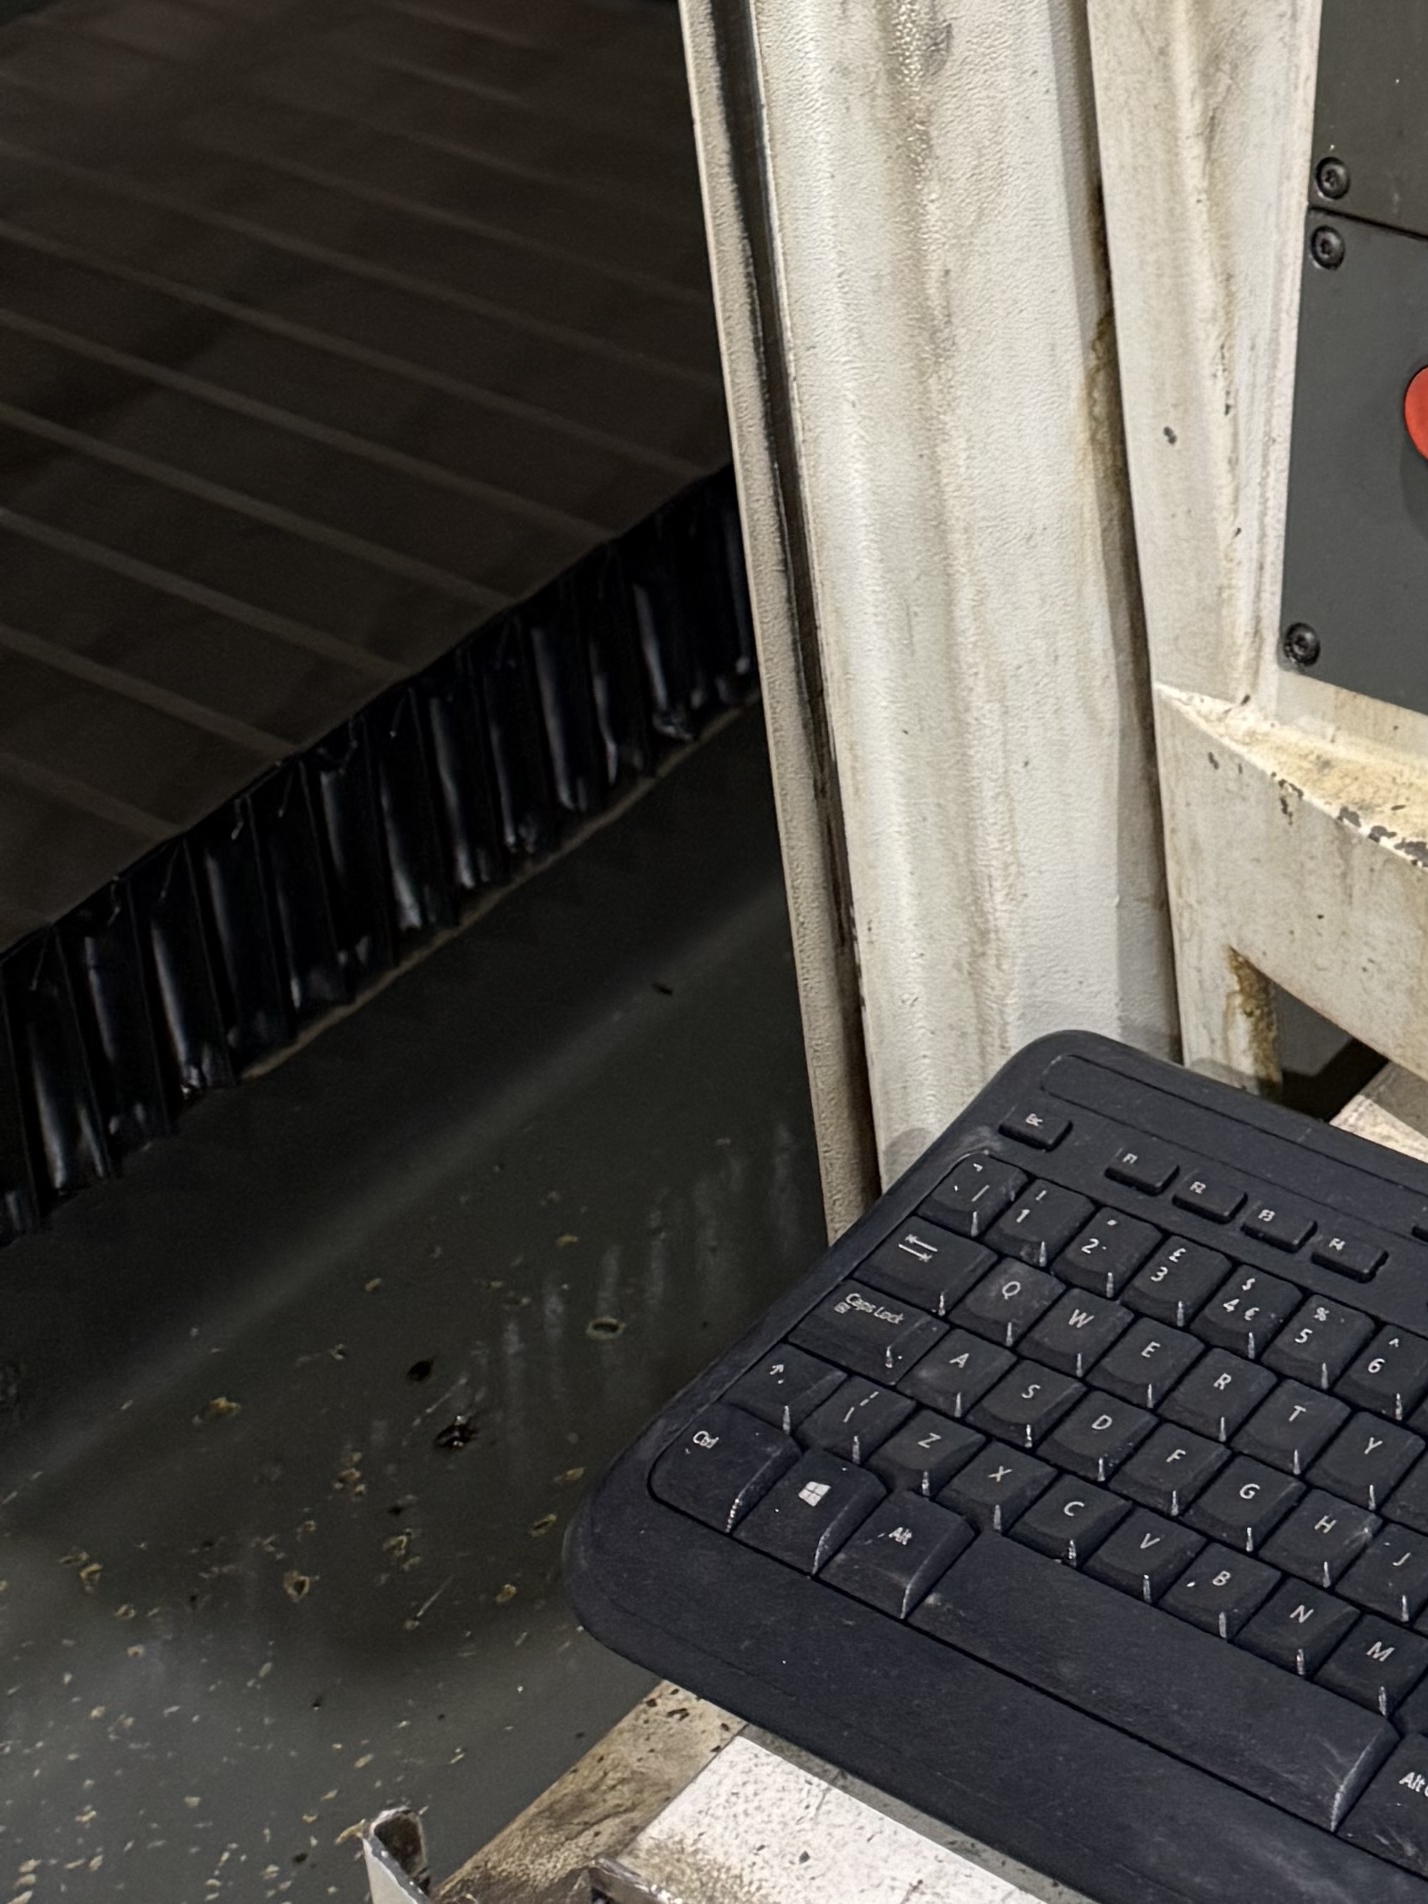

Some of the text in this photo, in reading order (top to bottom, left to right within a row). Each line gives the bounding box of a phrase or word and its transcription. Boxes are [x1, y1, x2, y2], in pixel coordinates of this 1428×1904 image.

[1002, 1281, 1022, 1300] Q
[844, 1292, 873, 1316] Caps
[1069, 1309, 1095, 1328] W
[1142, 1342, 1161, 1359] E
[1214, 1373, 1231, 1390] R
[1289, 1406, 1306, 1422] T
[1364, 1436, 1382, 1454] Y
[1400, 1771, 1424, 1790] Alt
